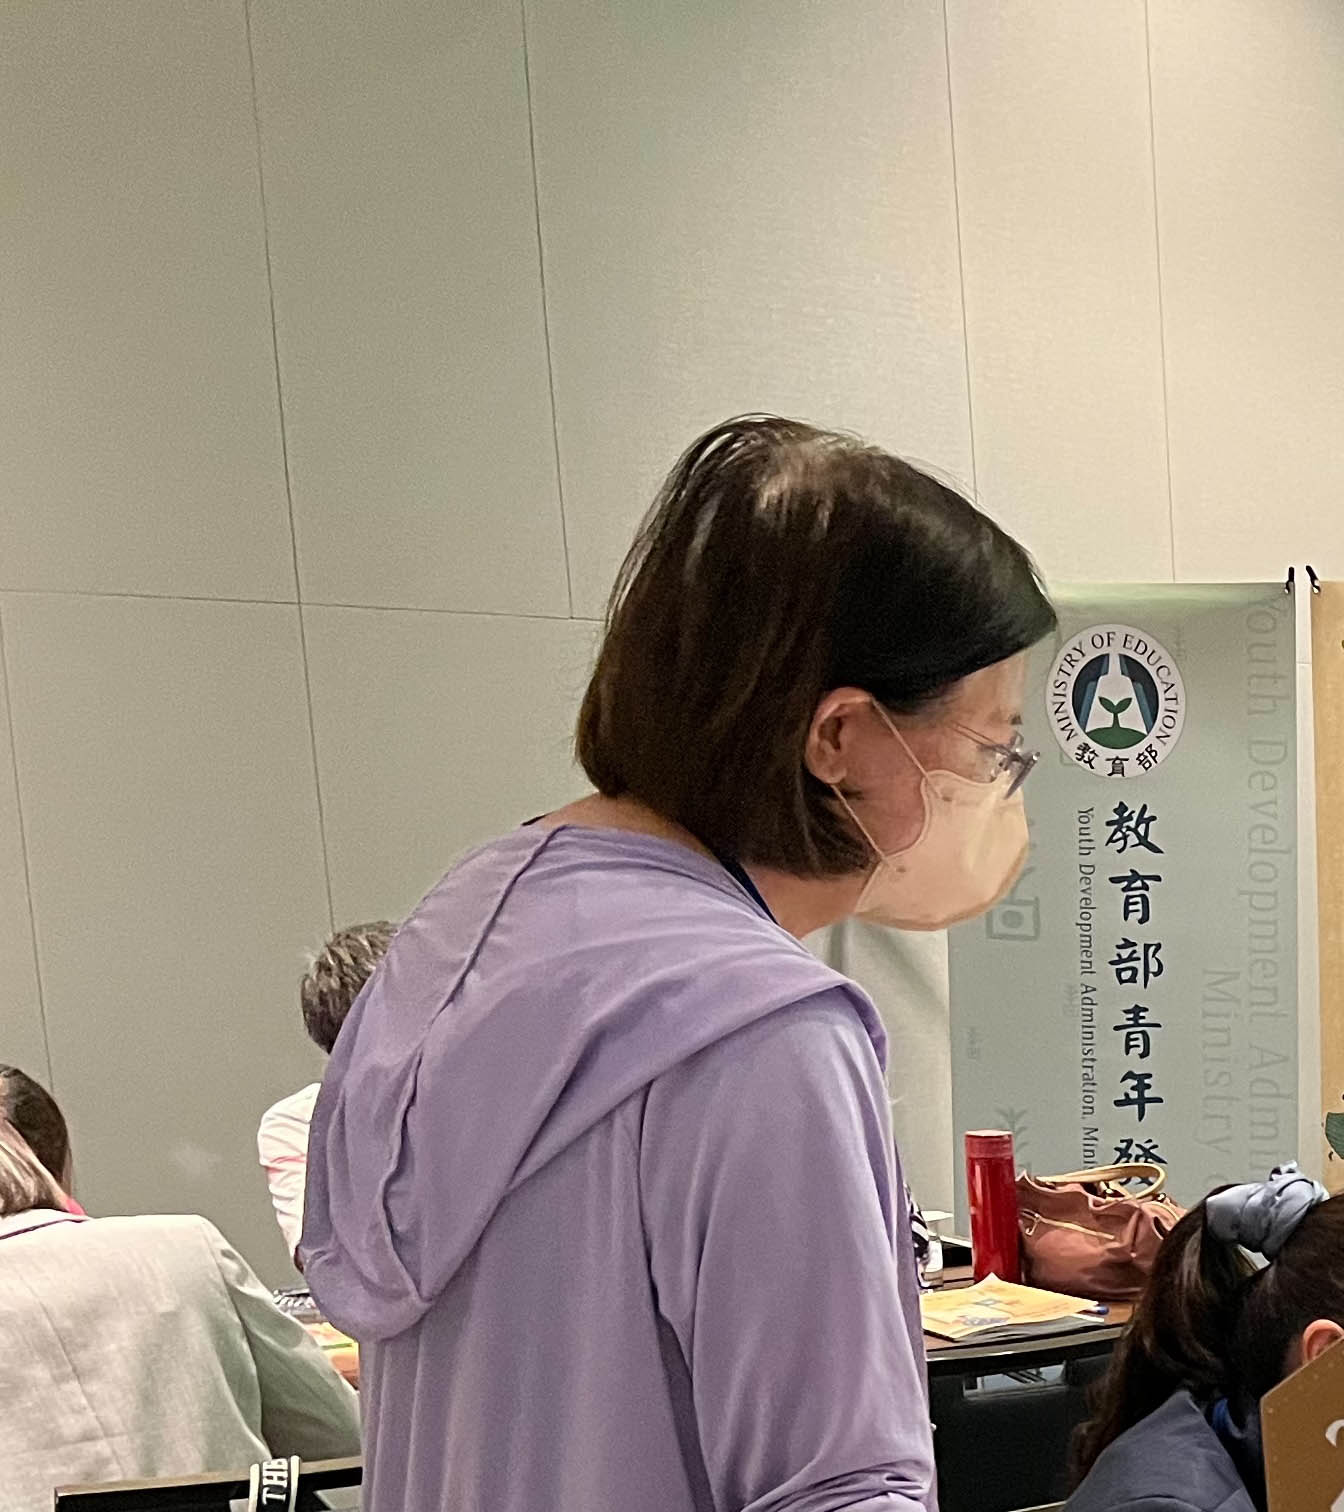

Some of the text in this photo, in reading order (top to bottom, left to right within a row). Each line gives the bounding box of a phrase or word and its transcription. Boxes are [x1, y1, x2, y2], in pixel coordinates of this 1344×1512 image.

[1052, 631, 1179, 746] MINISTRY OF EDUCATION
[1074, 742, 1161, 778] 教育部
[1077, 806, 1095, 856] Youth
[1075, 863, 1098, 976] Development
